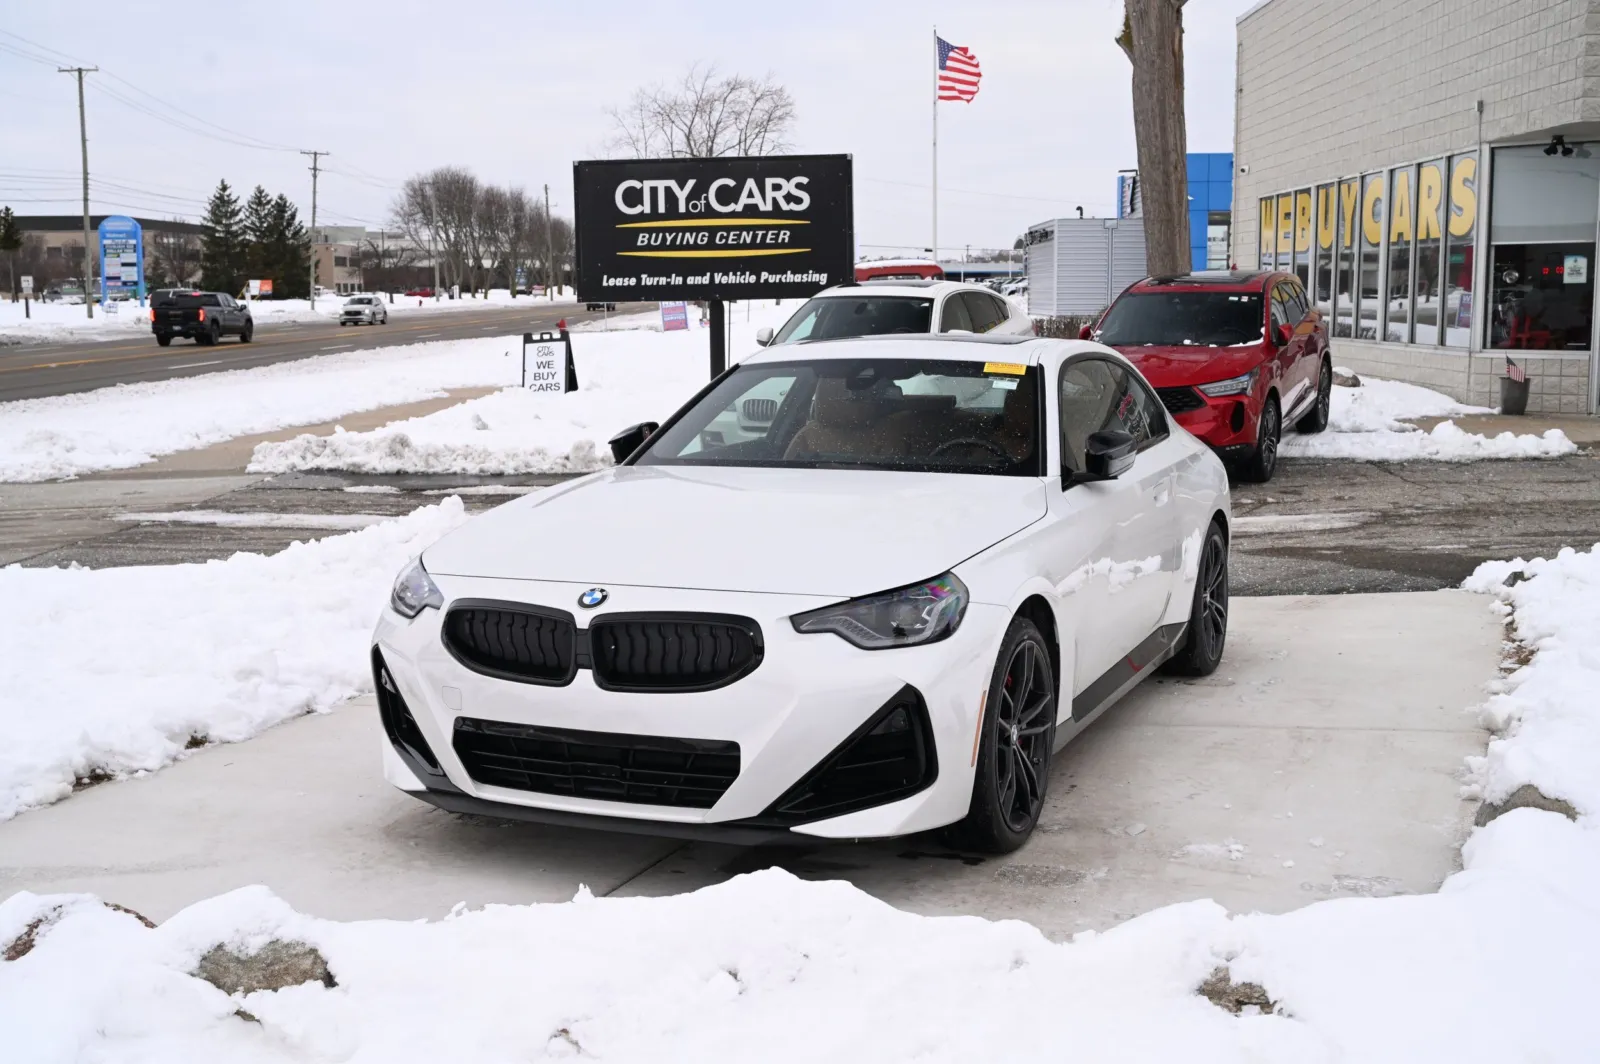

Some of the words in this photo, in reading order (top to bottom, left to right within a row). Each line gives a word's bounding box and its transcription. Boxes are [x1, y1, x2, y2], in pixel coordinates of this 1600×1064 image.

[614, 179, 697, 215] CITY
[688, 193, 707, 213] of
[708, 176, 811, 213] CARS
[1296, 183, 1358, 252] BUY
[1363, 158, 1477, 244] CARS
[637, 231, 709, 246] BUYING
[715, 230, 791, 244] CENTER
[602, 274, 637, 287] Lease
[640, 273, 683, 286] Turn-In
[686, 272, 711, 285] and
[714, 271, 757, 285] Vehicle
[760, 269, 828, 286] Purchasing
[536, 360, 555, 370] WE
[533, 371, 557, 381] BUY
[529, 382, 561, 392] CARS
